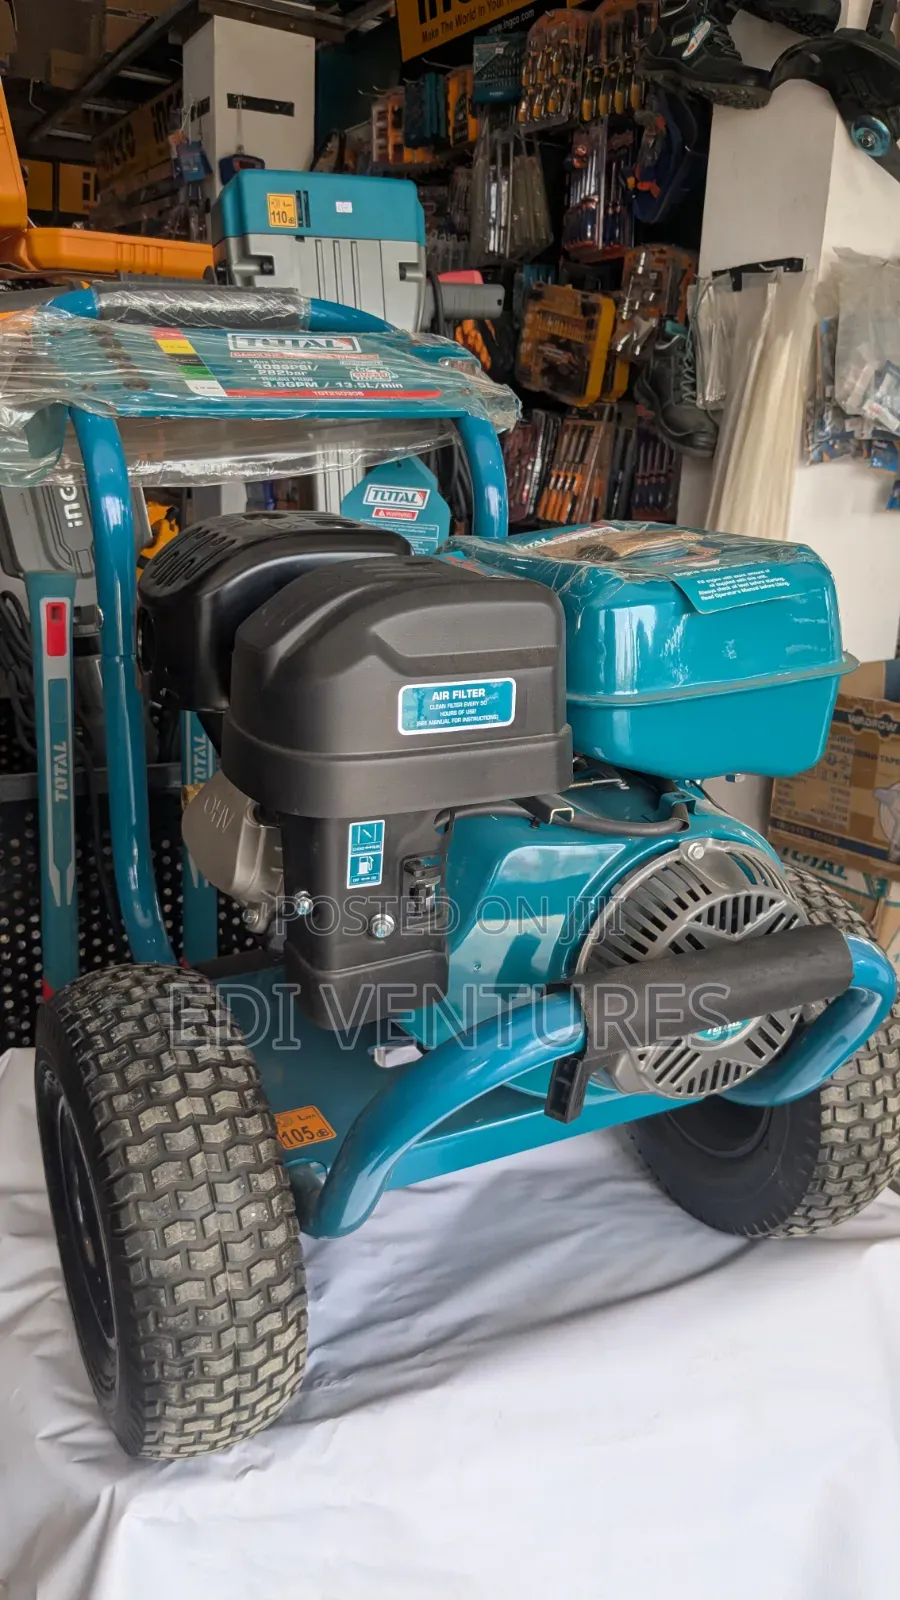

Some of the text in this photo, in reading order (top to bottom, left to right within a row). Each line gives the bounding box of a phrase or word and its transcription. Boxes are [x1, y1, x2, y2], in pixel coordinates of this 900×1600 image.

[421, 28, 439, 42] Make
[441, 21, 454, 34] The
[455, 9, 477, 29] World
[479, 6, 487, 18] In
[271, 210, 288, 224] 110
[239, 337, 344, 350] TOTAL
[372, 489, 418, 504] TOTAL
[432, 688, 486, 701] AIR FILTER
[53, 740, 68, 803] TOTAL
[281, 1125, 330, 1145] 105 dB
